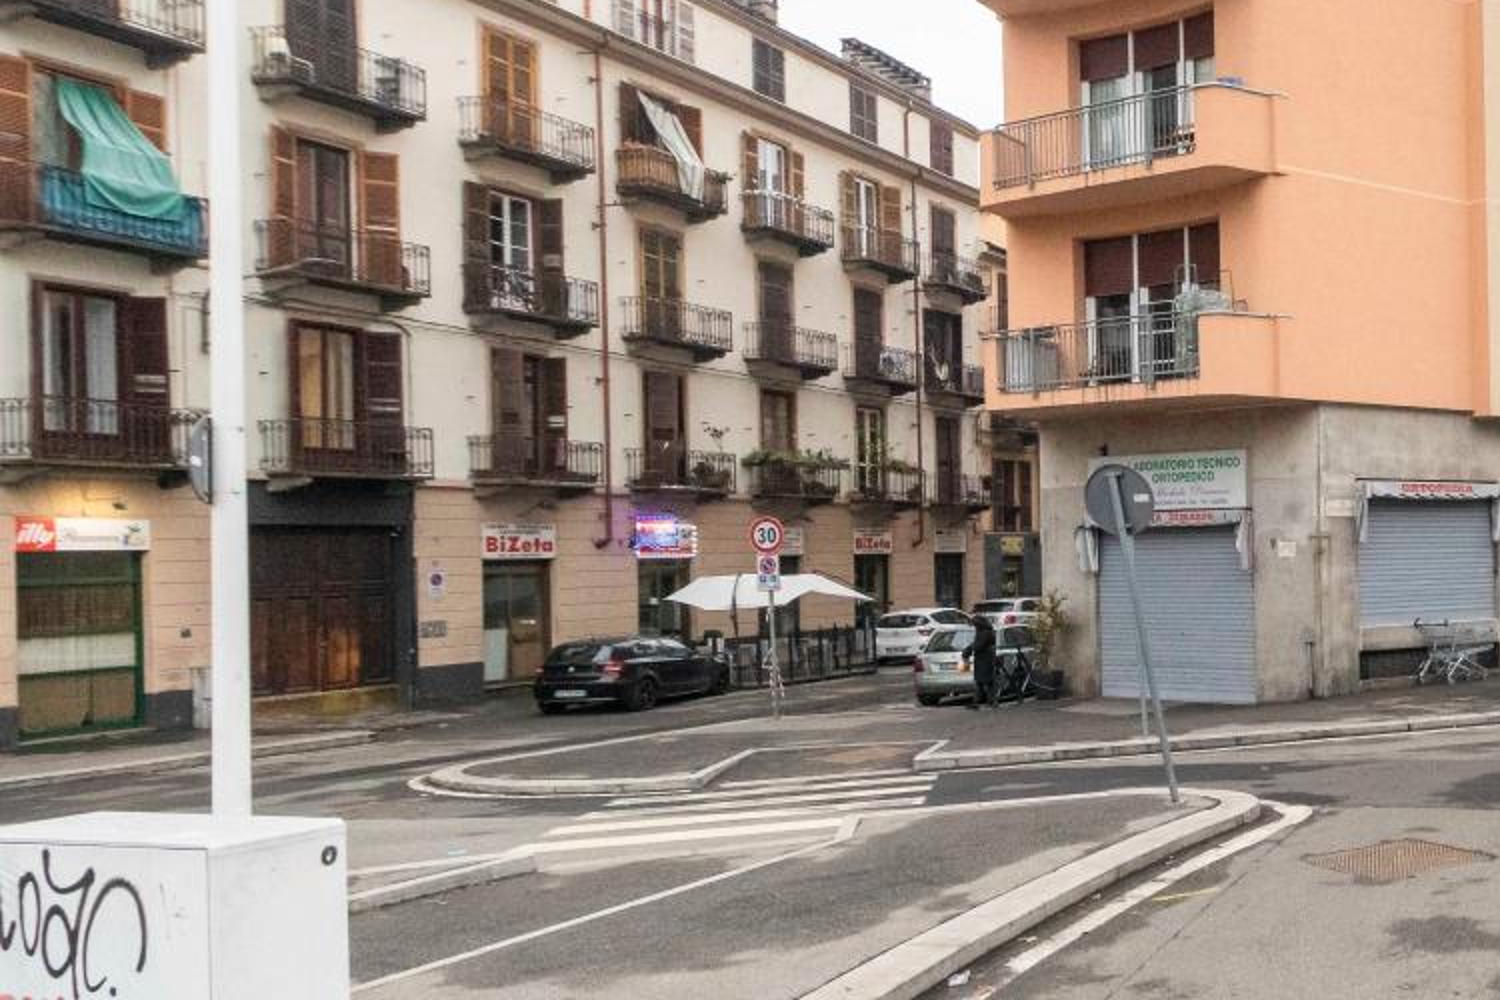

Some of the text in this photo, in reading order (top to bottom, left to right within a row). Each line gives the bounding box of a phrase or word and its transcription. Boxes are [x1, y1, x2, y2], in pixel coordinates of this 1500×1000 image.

[1197, 456, 1241, 469] TECNICO
[1151, 471, 1215, 483] ORTOPEDICO
[757, 527, 777, 544] 30
[485, 536, 553, 553] BiZeta
